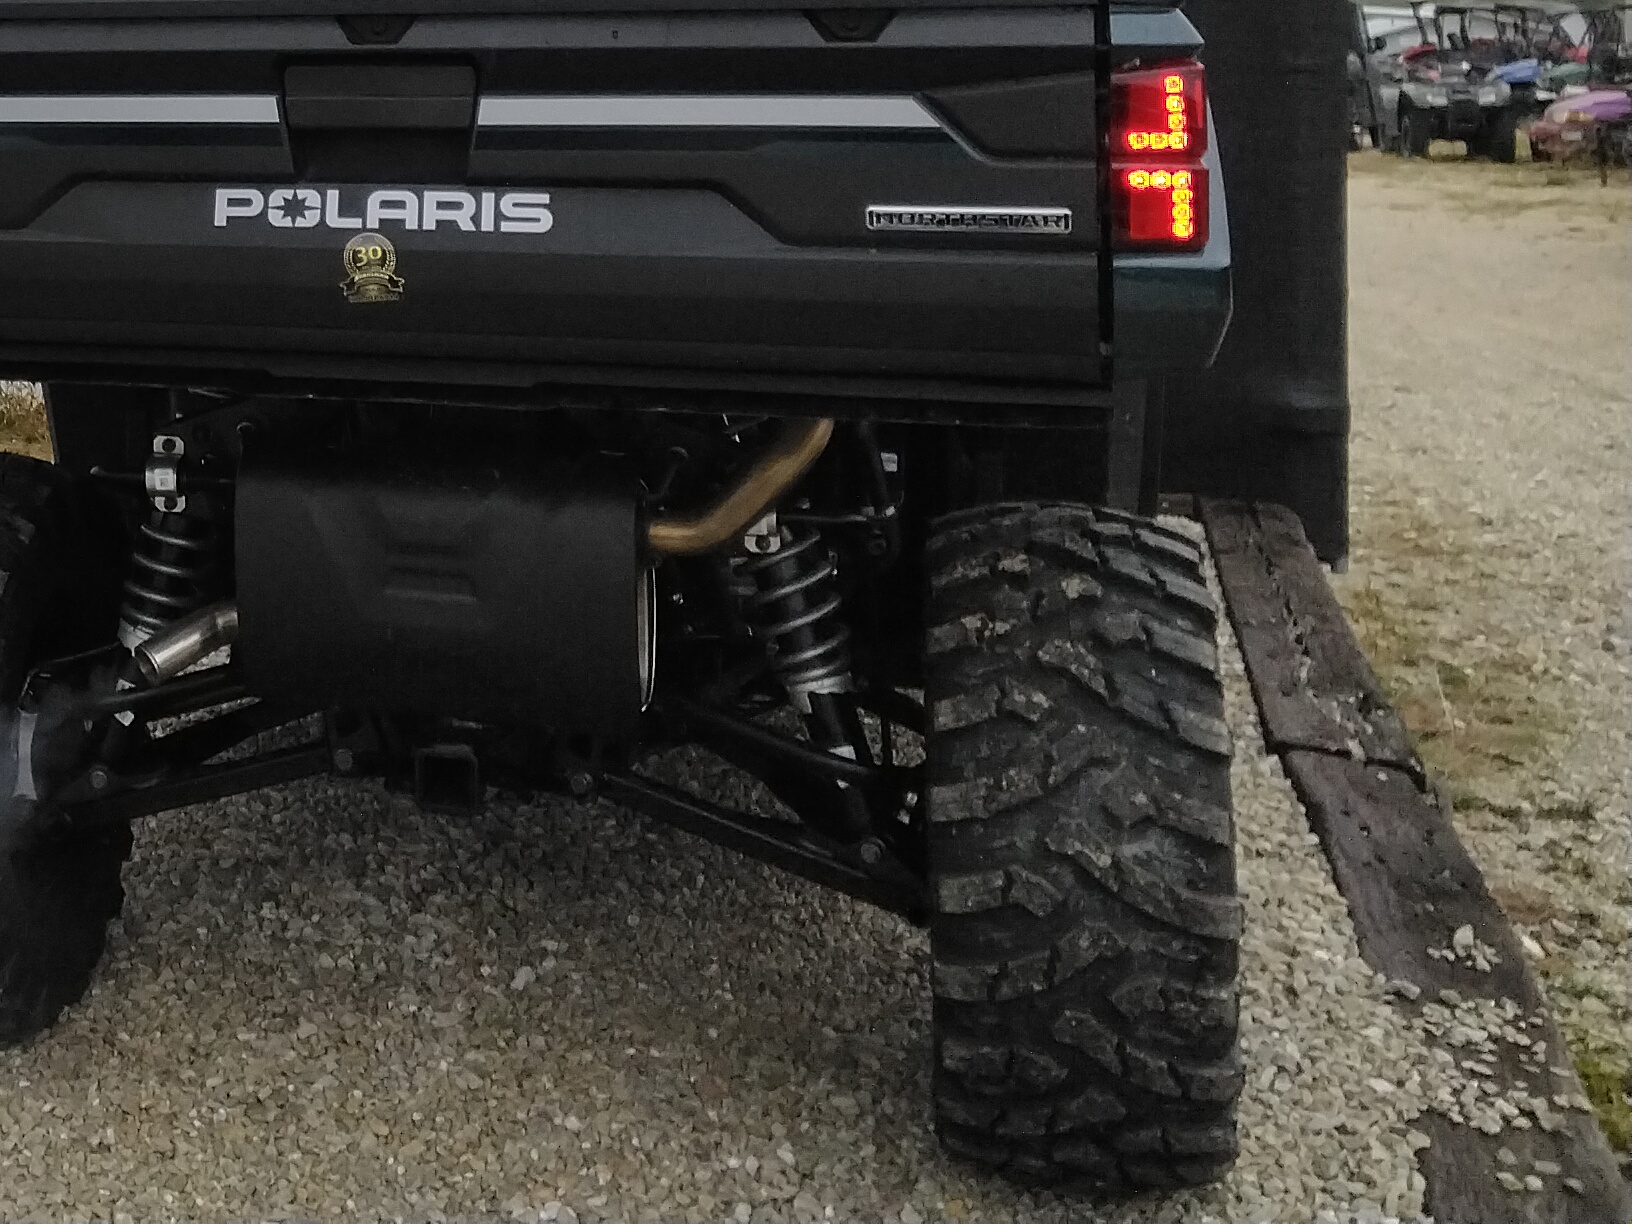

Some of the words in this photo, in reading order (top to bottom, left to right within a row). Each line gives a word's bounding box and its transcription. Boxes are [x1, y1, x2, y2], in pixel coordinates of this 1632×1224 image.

[214, 188, 554, 233] POLARIS
[872, 211, 1066, 230] NORTHSTAR
[355, 245, 382, 267] 30
